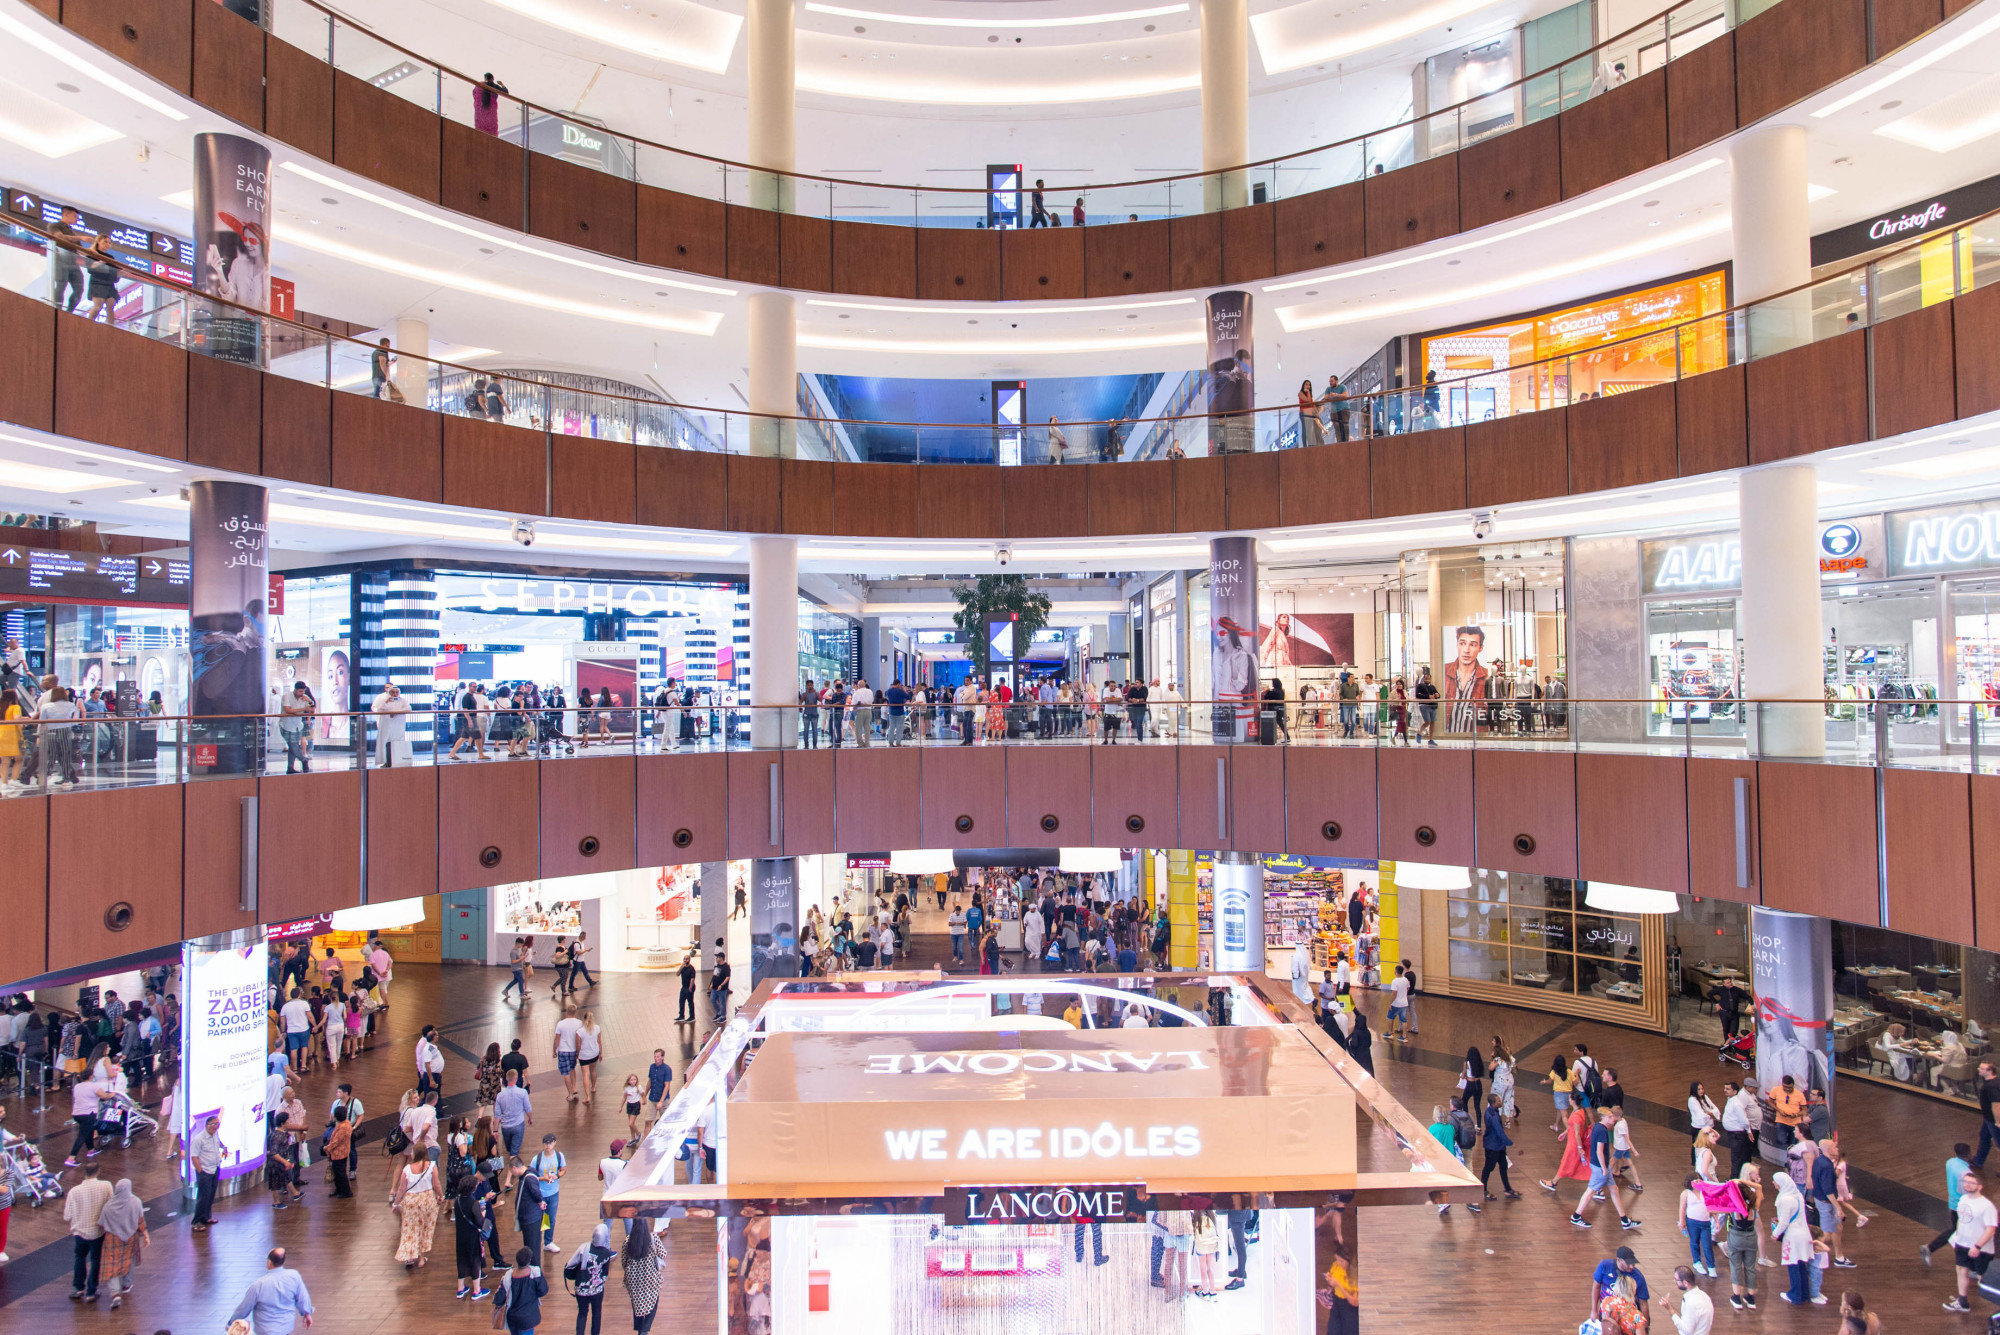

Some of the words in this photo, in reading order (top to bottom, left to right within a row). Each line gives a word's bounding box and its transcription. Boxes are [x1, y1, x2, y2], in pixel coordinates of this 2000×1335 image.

[562, 125, 602, 150] Dior
[1869, 202, 1947, 239] Christofle
[276, 293, 285, 313] 1
[480, 578, 722, 618] SEPHORA
[1215, 586, 1235, 597] FLY.
[588, 645, 626, 653] GUCCI
[1463, 708, 1522, 721] REISS
[850, 859, 856, 868] P
[1263, 856, 1306, 868] Hallmark
[1755, 963, 1777, 979] FLY.
[208, 988, 228, 998] THE
[208, 1012, 249, 1028] 3,000
[207, 1023, 251, 1037] PARKING
[864, 1050, 1211, 1076] LANCÔME
[885, 1129, 948, 1160] WE
[957, 1128, 1042, 1159] ARE
[1050, 1121, 1202, 1159] IDÔLES
[967, 1187, 1125, 1219] LANCÔME
